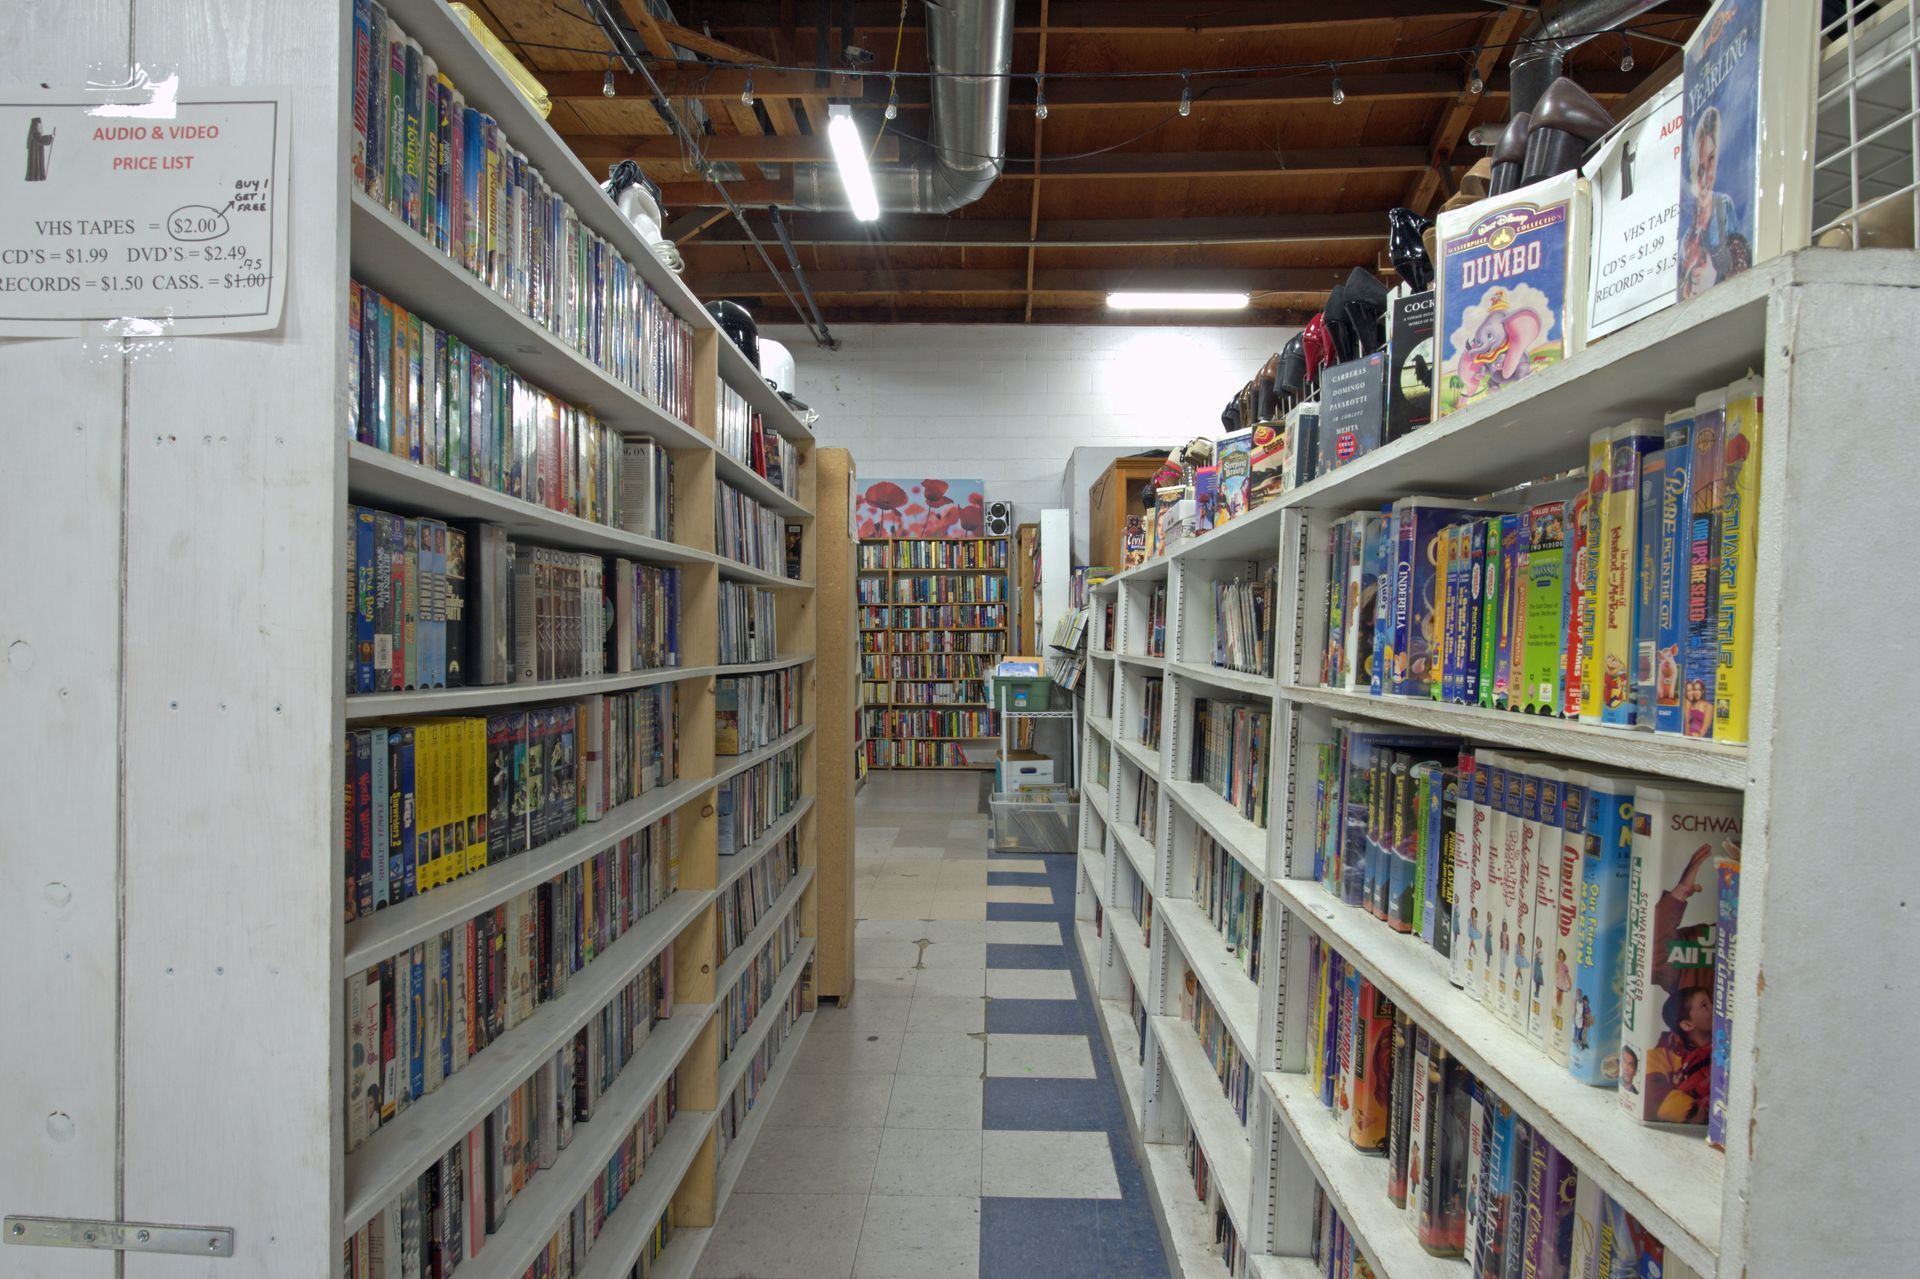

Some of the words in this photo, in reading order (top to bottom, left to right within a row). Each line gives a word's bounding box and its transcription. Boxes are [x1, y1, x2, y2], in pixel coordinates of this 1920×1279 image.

[1689, 28, 1748, 119] YEARLING
[93, 126, 147, 141] AUDIO
[151, 125, 164, 140] &
[168, 125, 219, 140] VIDEO
[1659, 114, 1683, 140] AUD
[407, 114, 418, 178] Hound
[113, 156, 158, 170] PRICE
[162, 156, 194, 170] LIST
[427, 132, 437, 195] BAMBI
[235, 179, 259, 190] BUY
[235, 193, 258, 202] GET
[236, 203, 267, 212] FREE
[1516, 214, 1563, 233] COLLECTION
[1623, 220, 1646, 243] VHS
[1648, 203, 1681, 231] TAPE
[35, 220, 73, 236] VHS
[77, 219, 135, 235] TAPES
[174, 217, 217, 234] $2.00
[65, 247, 108, 265] $1.99
[204, 244, 246, 262] $2.49
[1448, 237, 1488, 254] MASTERPIECE
[1637, 235, 1665, 259] $1.99
[1462, 240, 1541, 290] DUMBO
[1595, 269, 1645, 303] RECORDS
[1656, 252, 1677, 275] $1.5
[101, 274, 143, 291] $1.50
[152, 273, 204, 290] CASS.
[1332, 367, 1367, 383] CARRERAS
[1332, 381, 1366, 396] DOMINGO
[1330, 395, 1368, 411] PAVAROTTI
[1336, 424, 1359, 435] MEHTA
[1532, 507, 1548, 516] VALUE
[1662, 467, 1687, 537] BABE
[1545, 541, 1563, 550] VIDEOS
[1692, 518, 1709, 541] OUR
[1719, 494, 1740, 587] STUART
[347, 540, 355, 569] DEAN
[1585, 517, 1600, 595] STUART
[1610, 526, 1622, 571] Ichabod
[1663, 538, 1672, 560] PIG
[1692, 541, 1708, 564] LIPS
[1662, 562, 1671, 576] IN
[1691, 564, 1707, 583] ARE
[347, 571, 355, 612] MARTIN
[420, 571, 432, 620] TITANIC
[433, 575, 445, 622] TITANIC
[1396, 561, 1410, 629] CINDERELLA
[1662, 580, 1671, 602] THE
[1689, 583, 1706, 622] SEALED
[1577, 596, 1586, 622] BEST
[1661, 605, 1671, 630] CITY
[1577, 625, 1584, 638] OF
[1583, 598, 1597, 660] LITTLE
[1717, 593, 1737, 668] LITTLE
[1574, 642, 1584, 676] JAMES
[1473, 809, 1485, 840] Baby
[1671, 814, 1742, 833] SCHWA
[1447, 831, 1457, 863] PRINCE
[1454, 829, 1471, 869] Heidi
[1471, 840, 1482, 866] Take
[1520, 823, 1533, 859] Baby
[1487, 843, 1503, 884] Heidi
[1519, 860, 1531, 889] Take
[1561, 845, 1579, 900] CURLY
[1446, 865, 1456, 904] CASPIAN
[1537, 857, 1556, 908] Heidi
[1589, 883, 1599, 913] Our
[1629, 857, 1641, 921] Jingle
[1517, 902, 1529, 929] Bow
[1560, 903, 1578, 936] TOP
[1577, 880, 1588, 964] MARTIN
[1584, 917, 1599, 969] Friend,
[1635, 892, 1649, 1002] SCHWARZENEGGER
[1668, 946, 1699, 964] All
[1717, 928, 1728, 959] and
[1623, 976, 1638, 1029] Way
[1713, 963, 1728, 1018] Listen!
[1412, 1089, 1424, 1133] COLONEL
[1472, 1121, 1481, 1156] Heidi
[1490, 1130, 1504, 1196] LITTLE
[1530, 1143, 1547, 1201] MUPPET
[1486, 1201, 1499, 1253] MEN
[1600, 1223, 1613, 1279] HOMEW
